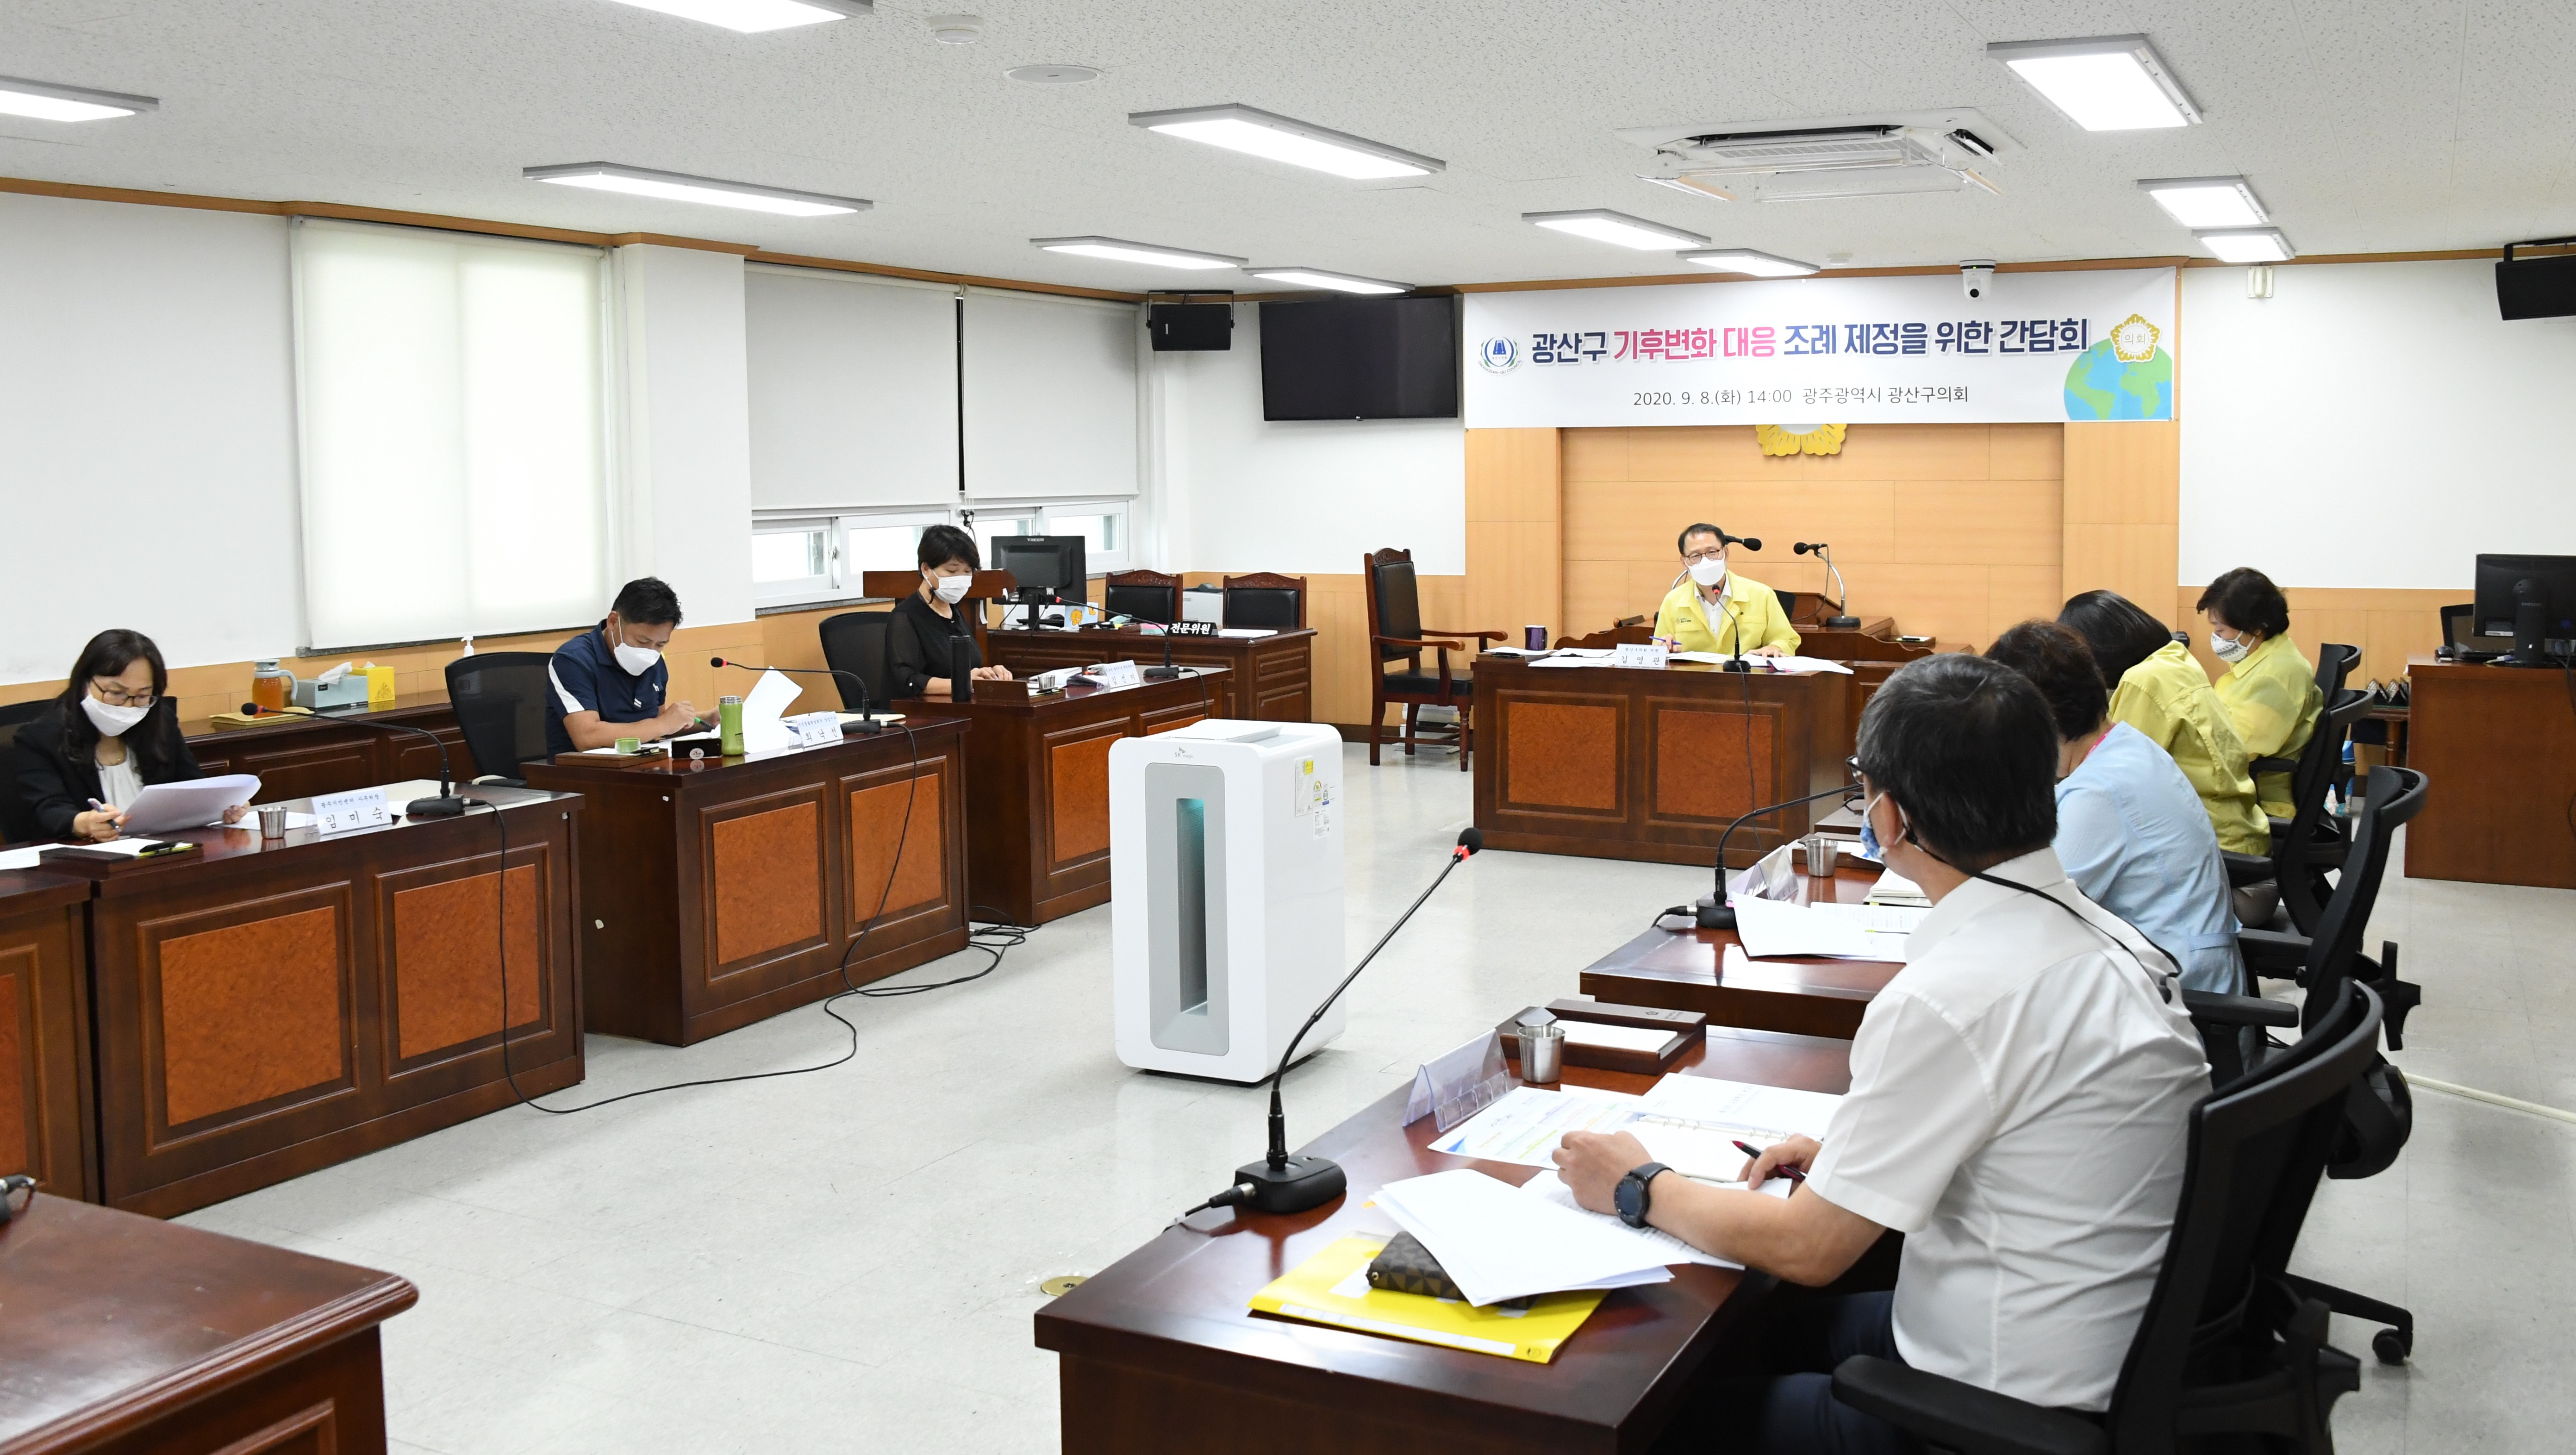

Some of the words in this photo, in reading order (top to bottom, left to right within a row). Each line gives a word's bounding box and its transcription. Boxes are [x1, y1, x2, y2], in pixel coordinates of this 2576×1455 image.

[1532, 332, 1607, 363] 광산구
[1614, 328, 1717, 360] 기후변화
[1724, 326, 1776, 357] 대응
[1784, 324, 1836, 356] 조례
[1844, 322, 1928, 355] 제정을
[1935, 320, 1992, 354] 위한
[1999, 318, 2088, 353] 간담회
[2124, 333, 2145, 344] 의회
[1634, 392, 1675, 406] 2020.
[1681, 392, 1694, 405] 9.
[1700, 389, 1741, 405] 8.(화)
[1748, 389, 1791, 403] 14:00
[1803, 387, 1882, 404] 광주광역시
[1888, 386, 1969, 403] 광산구의회
[1170, 622, 1210, 635] 전문위원
